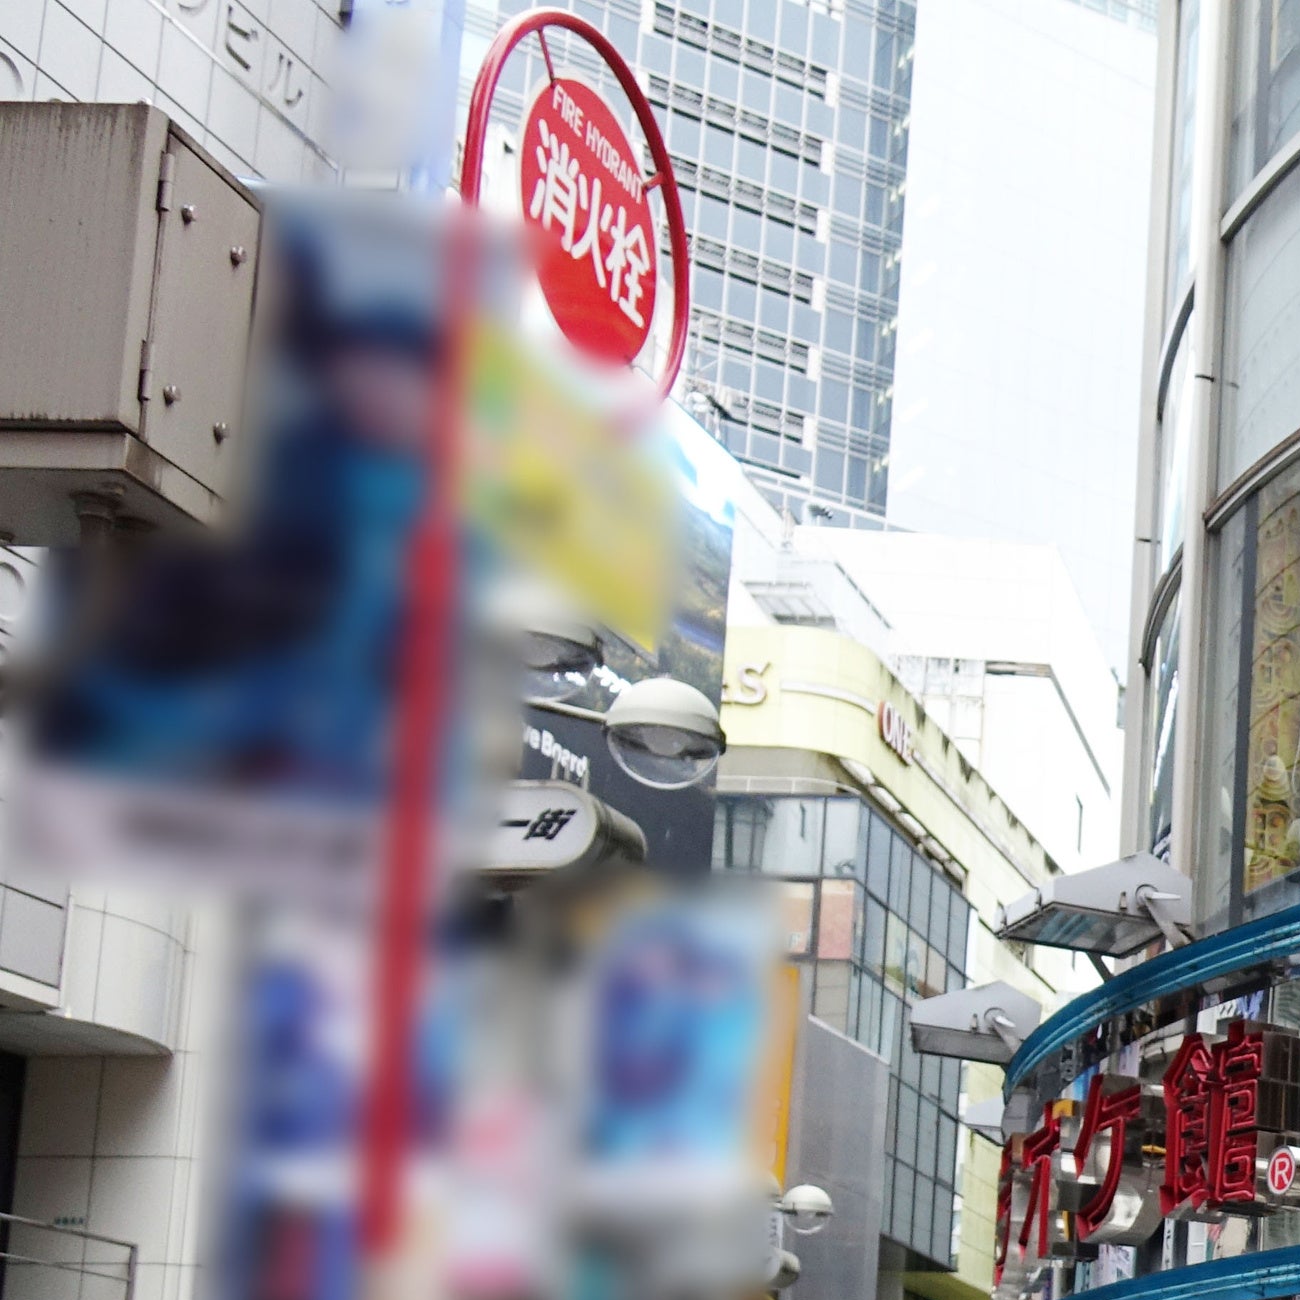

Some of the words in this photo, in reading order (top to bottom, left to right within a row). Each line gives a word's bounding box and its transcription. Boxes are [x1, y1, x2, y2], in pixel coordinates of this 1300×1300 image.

[530, 118, 650, 328] 消火栓
[553, 84, 583, 137] FIRE
[586, 120, 642, 203] HYDRANT
